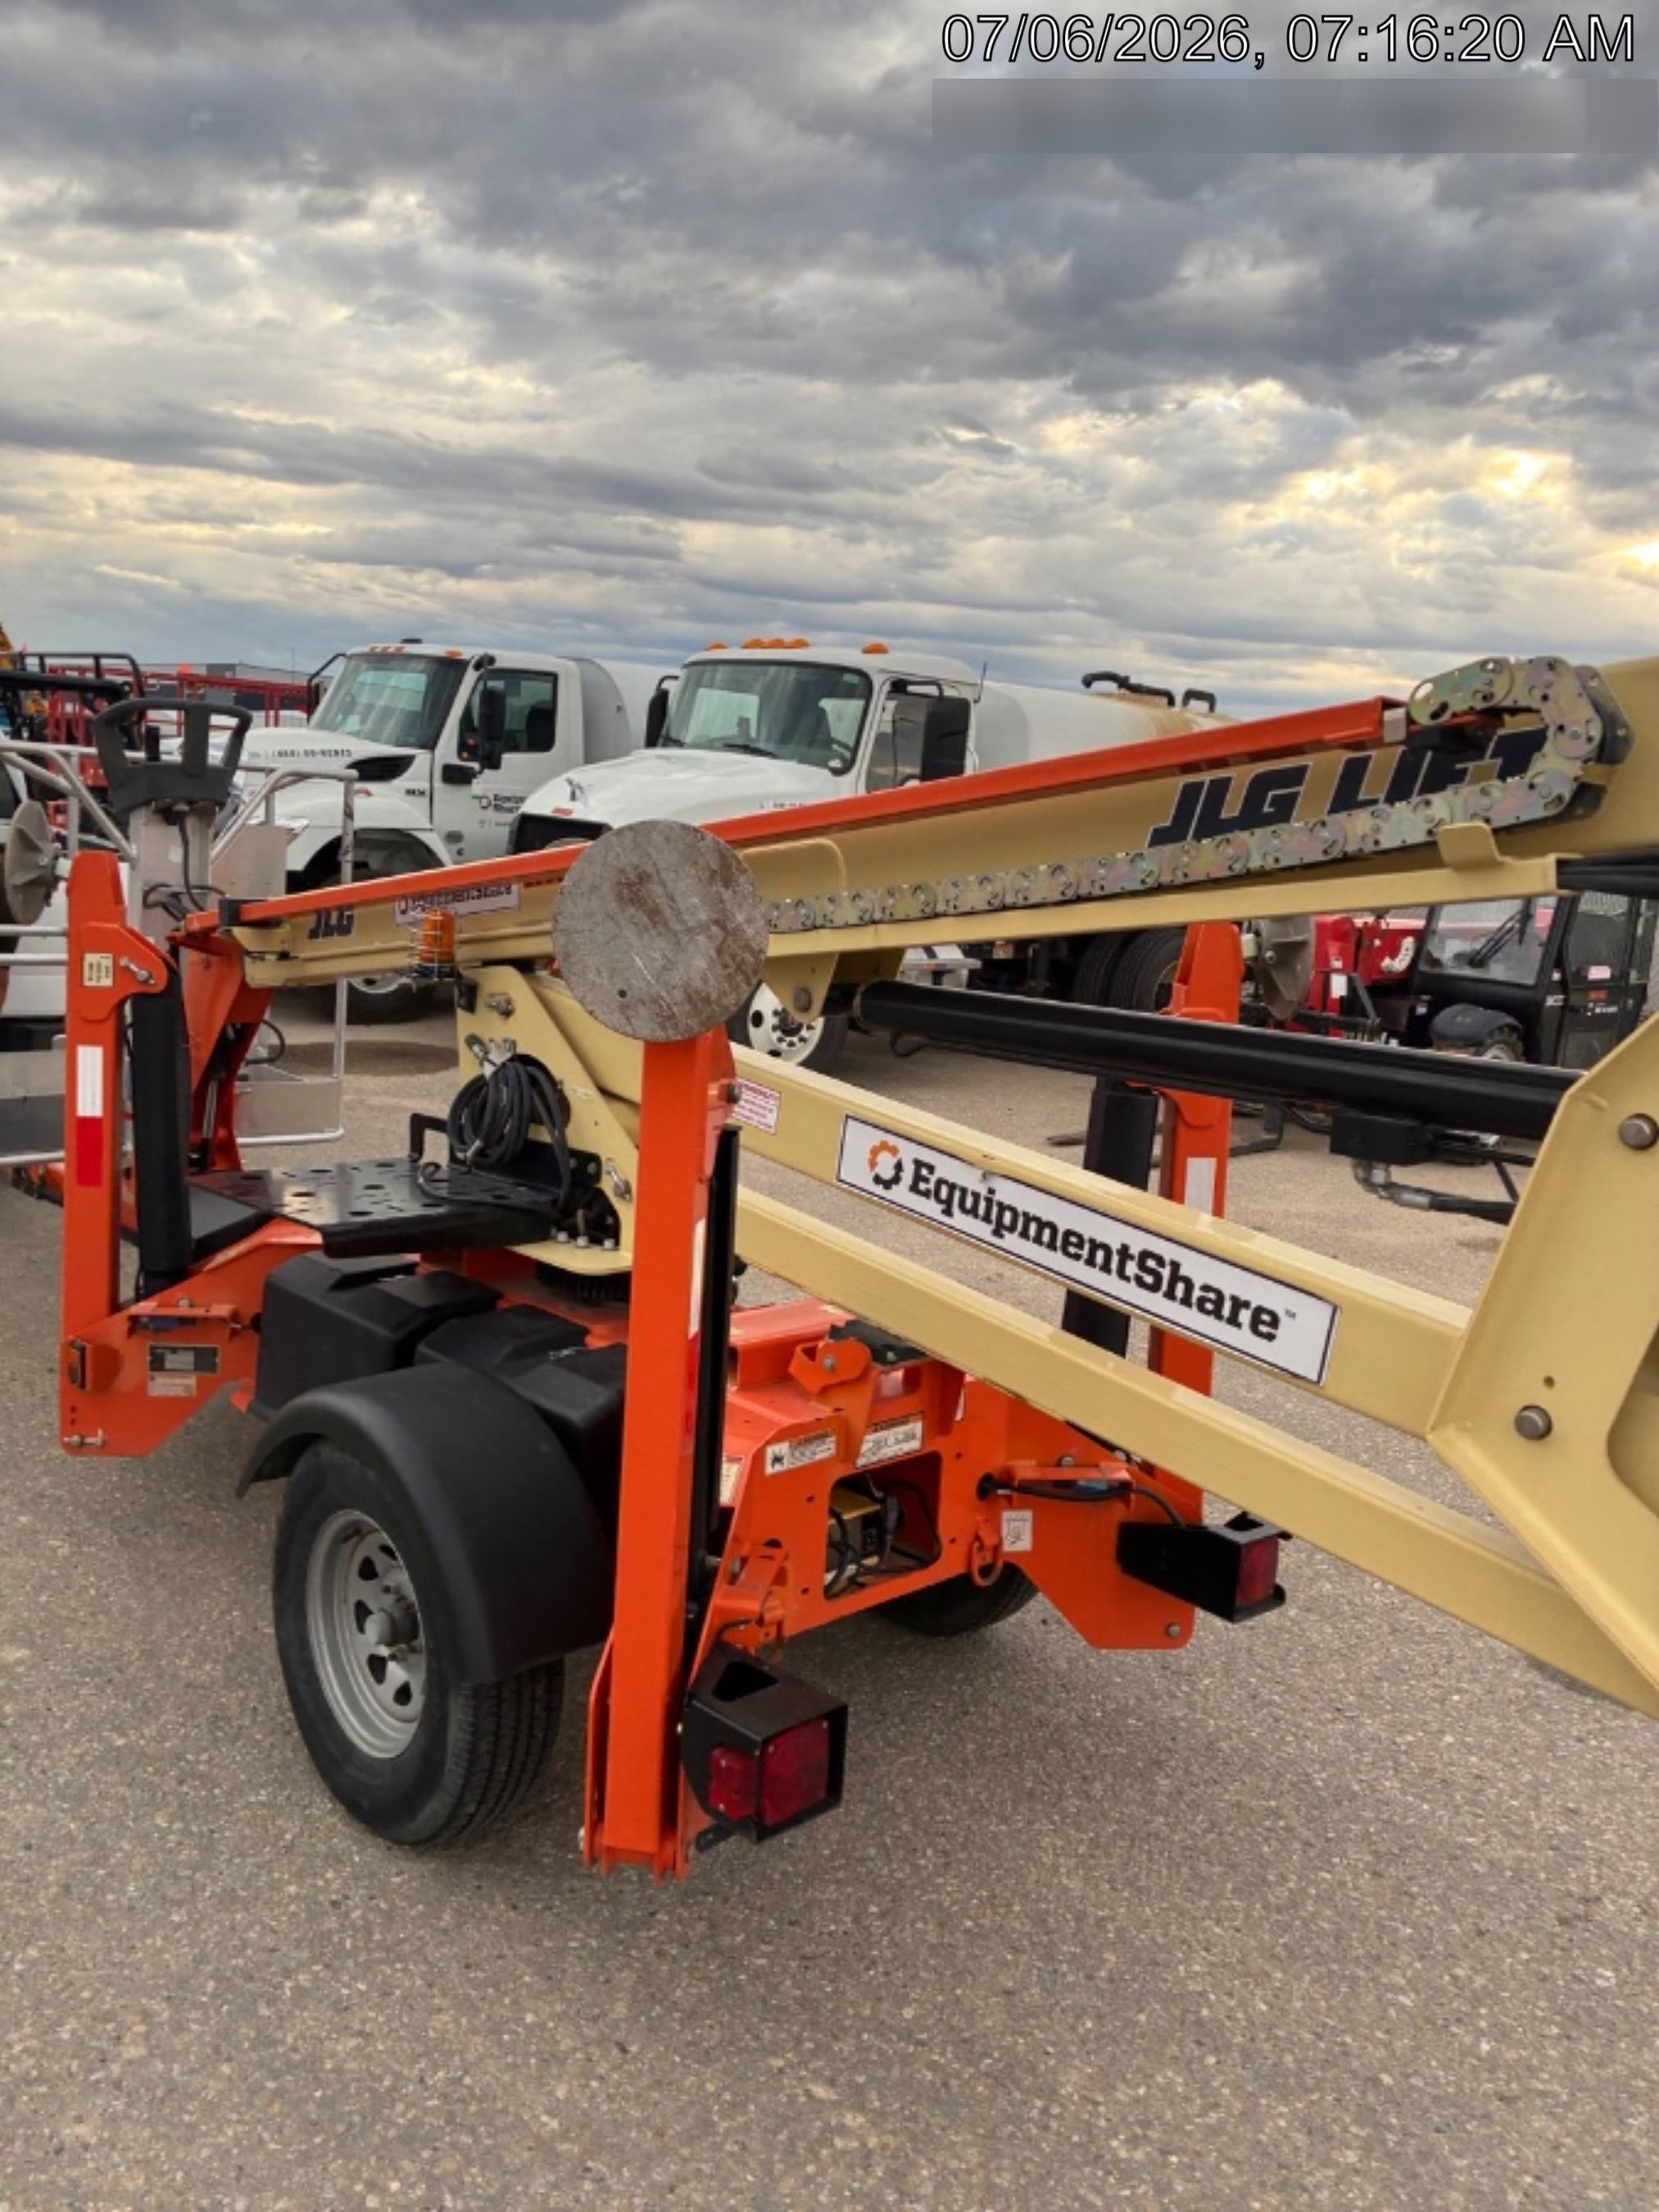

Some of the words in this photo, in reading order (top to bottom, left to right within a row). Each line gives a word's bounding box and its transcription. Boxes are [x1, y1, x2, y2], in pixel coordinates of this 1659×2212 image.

[1149, 764, 1311, 848] JLG
[1326, 728, 1548, 815] LIFT
[308, 907, 354, 939] JLG
[909, 1158, 1281, 1343] EquipmentShare
